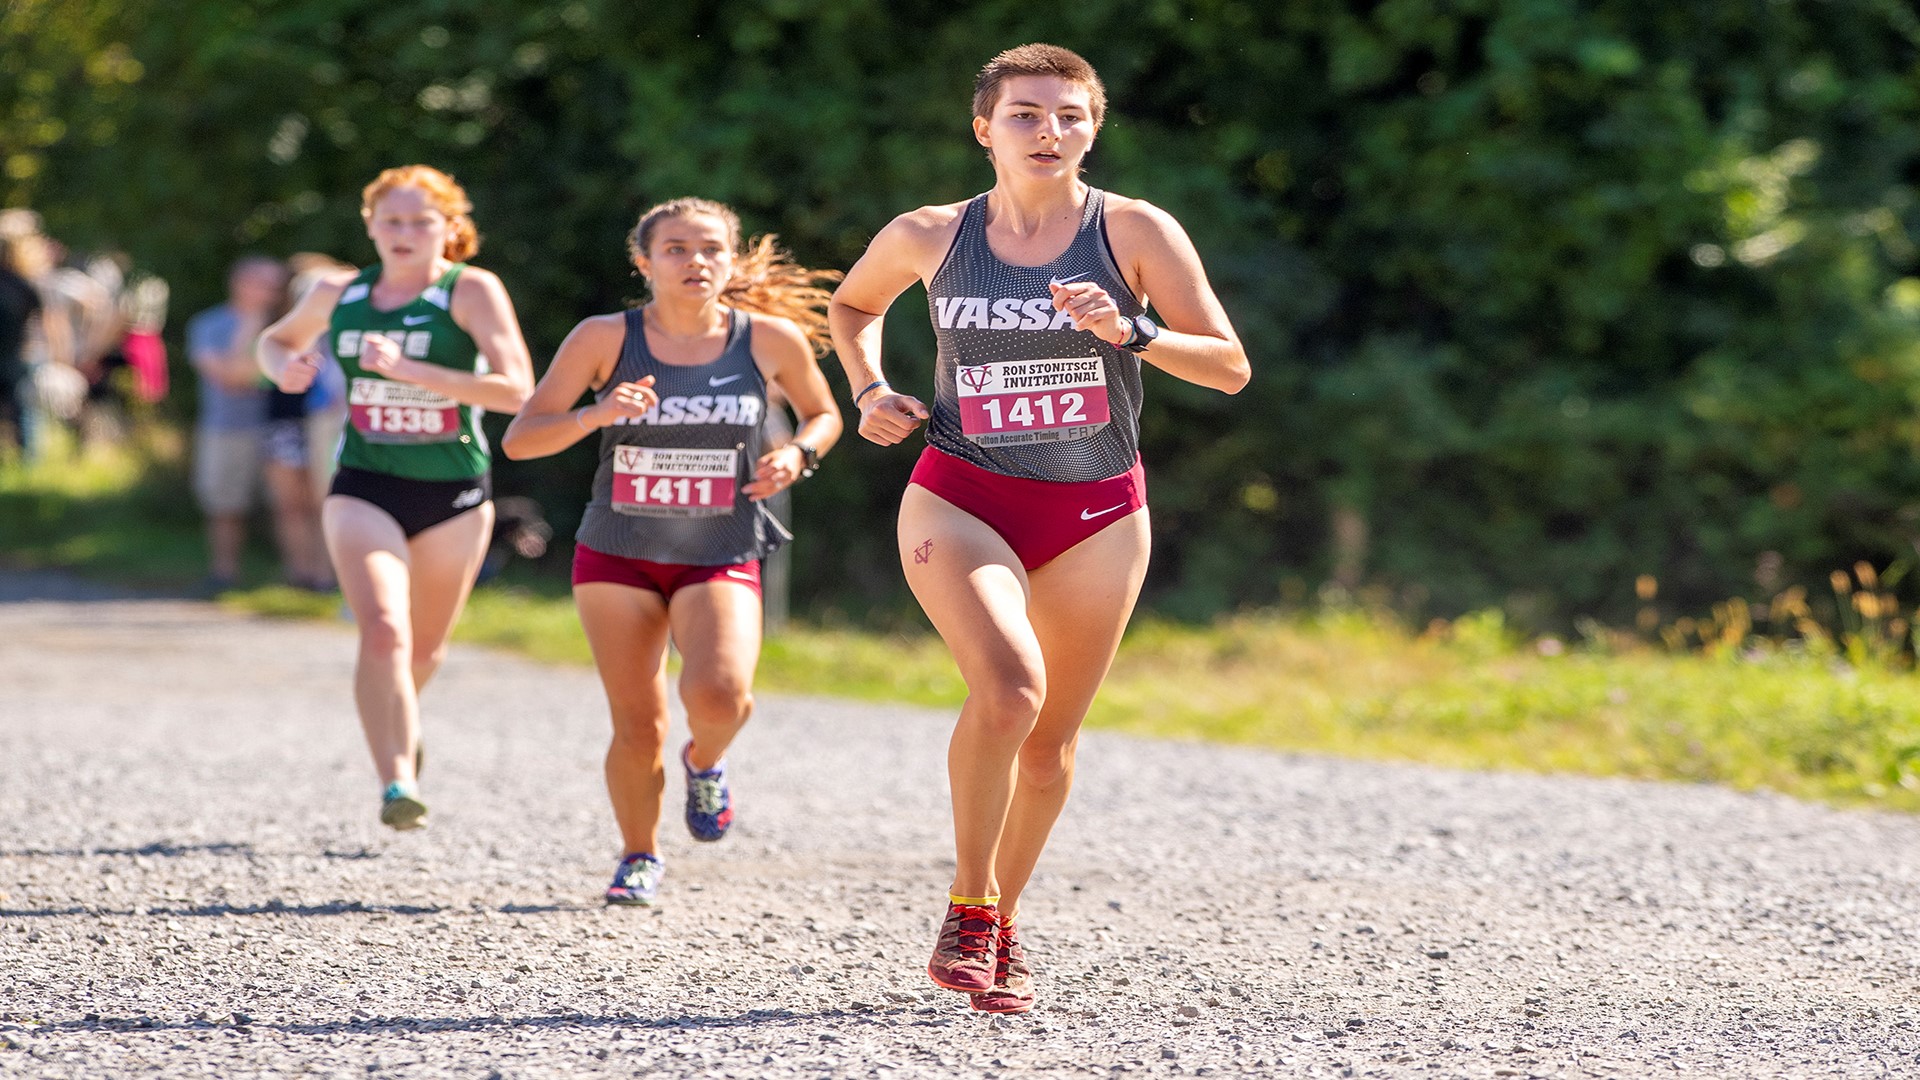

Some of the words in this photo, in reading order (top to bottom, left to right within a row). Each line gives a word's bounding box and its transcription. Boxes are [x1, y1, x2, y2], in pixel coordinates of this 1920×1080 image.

[934, 297, 1117, 330] VASSA
[1002, 365, 1027, 376] RON
[1029, 360, 1098, 374] STONITSCH
[1003, 372, 1099, 389] INVITATIONAL
[366, 406, 444, 434] 1338
[613, 394, 760, 426] ASSAR
[982, 392, 1087, 429] 1412
[975, 434, 999, 445] Fulton
[999, 432, 1033, 444] Accurate
[1033, 430, 1060, 442] Timing
[630, 476, 712, 505] 1411
